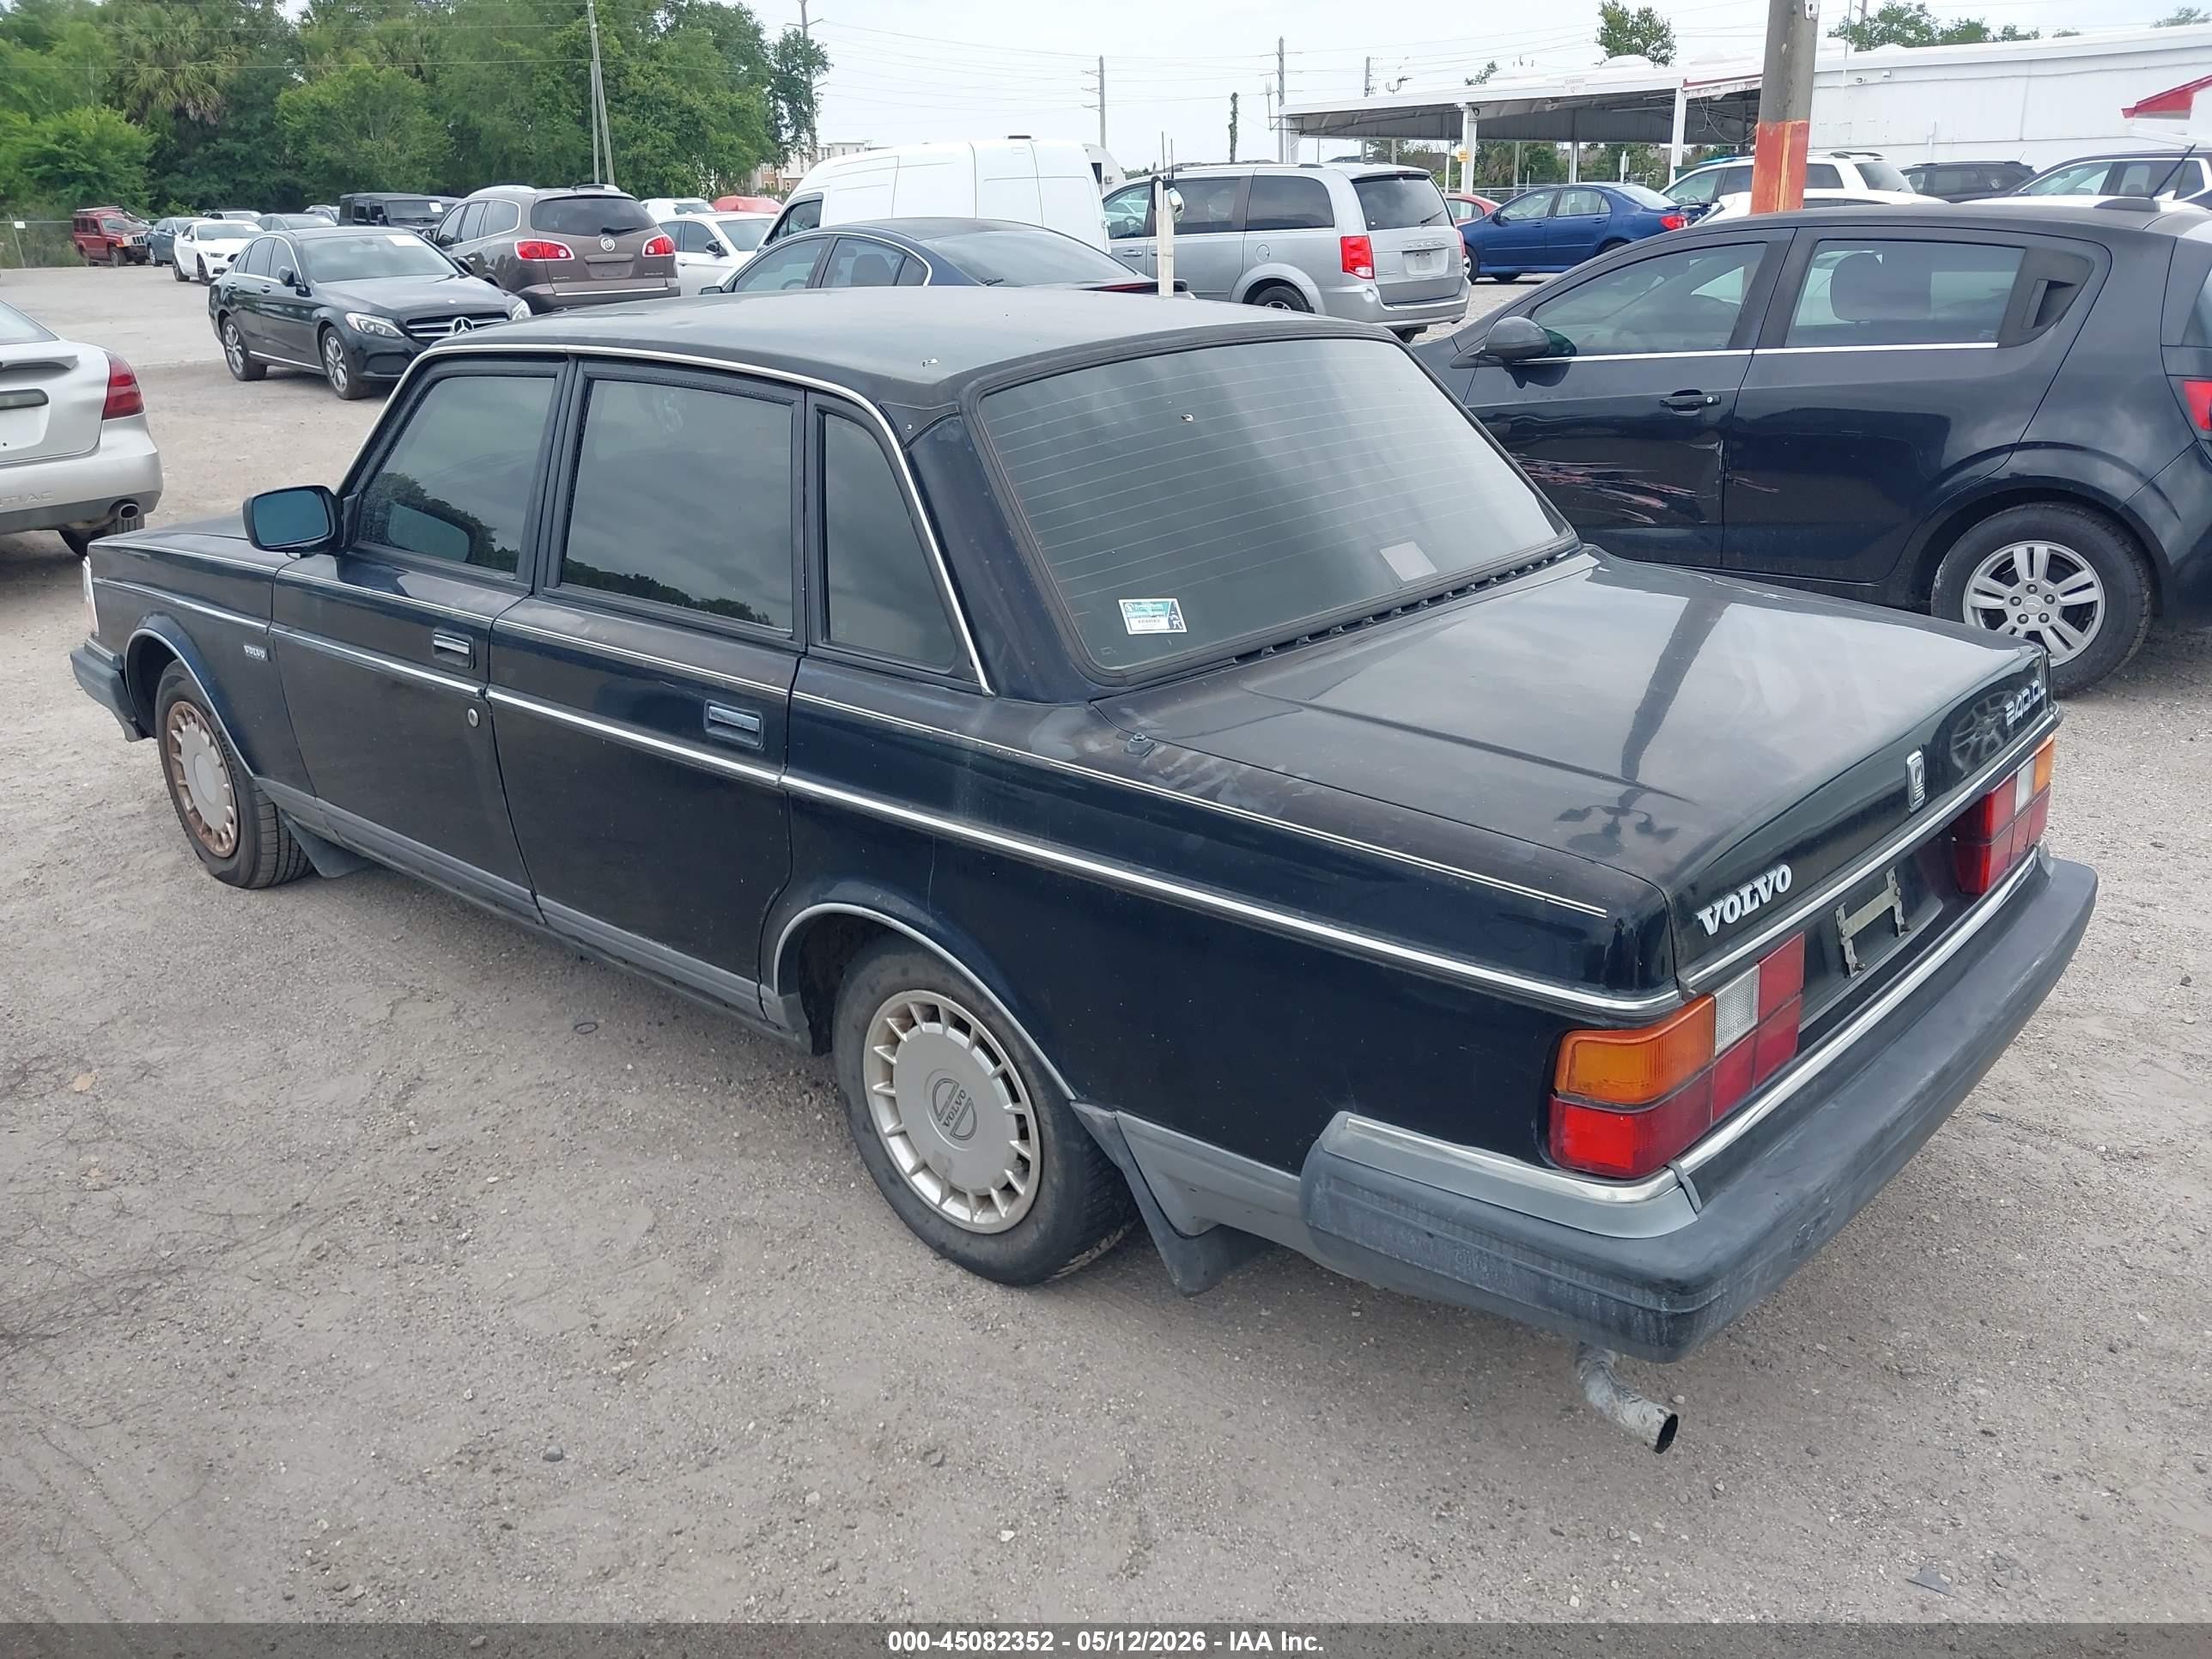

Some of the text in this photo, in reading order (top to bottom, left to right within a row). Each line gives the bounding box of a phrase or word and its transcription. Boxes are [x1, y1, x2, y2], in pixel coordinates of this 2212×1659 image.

[243, 645, 265, 658] VOLVO
[1695, 864, 1792, 936] VOLVO
[942, 1089, 967, 1127] VOLVO
